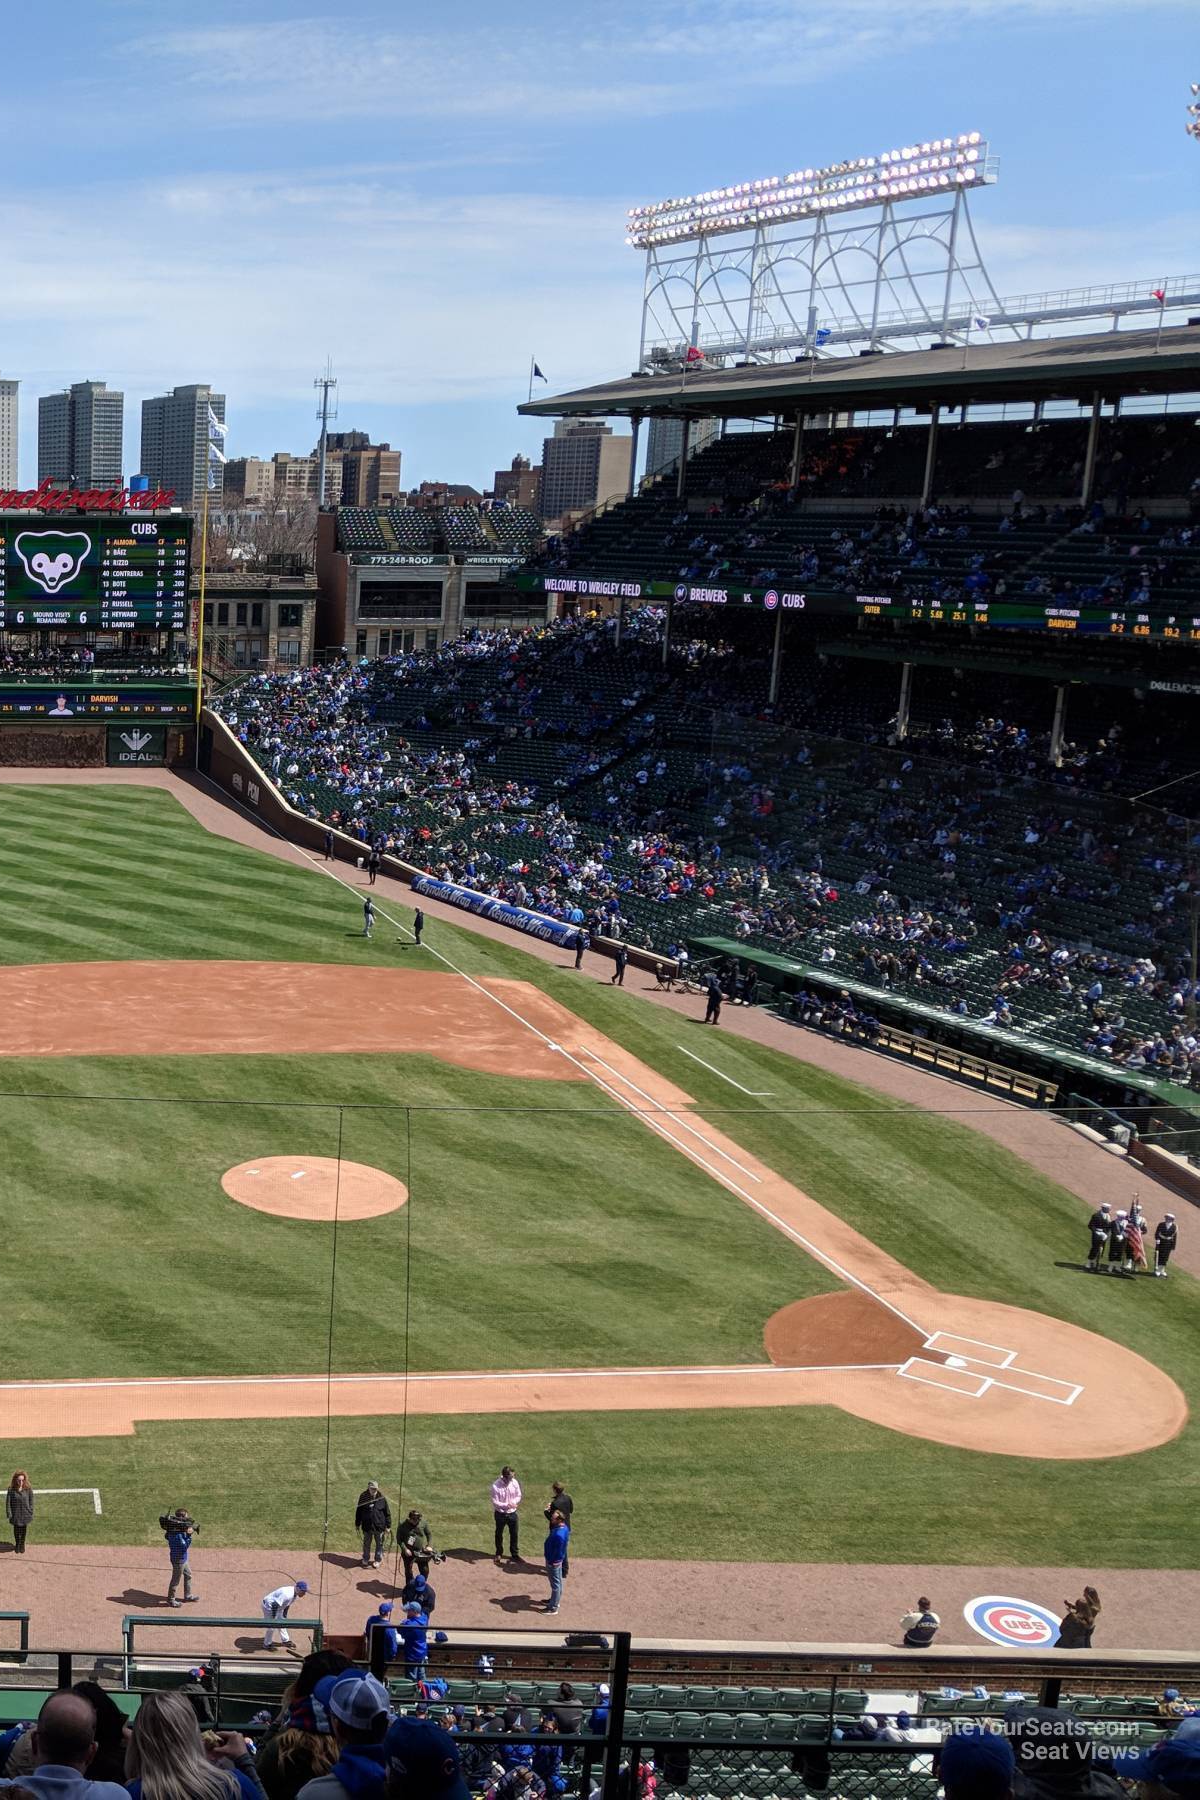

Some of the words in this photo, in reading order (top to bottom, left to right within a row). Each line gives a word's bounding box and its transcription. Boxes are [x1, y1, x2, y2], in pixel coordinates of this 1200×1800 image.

[131, 523, 157, 534] CUBS
[370, 556, 434, 564] 773-248-ROOF
[544, 579, 576, 592] WELCOME
[578, 581, 587, 593] TO
[588, 581, 620, 595] WRIGLEY
[620, 583, 641, 597] FIELD
[690, 587, 728, 603] BREWERS
[782, 593, 806, 608] CUBS
[856, 595, 874, 604] VISITING
[864, 605, 881, 614] SUTER
[931, 600, 941, 608] ERA
[17, 611, 24, 623] 6
[80, 611, 87, 624] 6
[912, 609, 922, 617] 1-2
[953, 612, 966, 621] 25.1
[1045, 608, 1059, 617] CUBS
[1059, 609, 1080, 617] PITCHER
[1048, 619, 1077, 629] DARVISH
[1169, 616, 1175, 624] IP
[1111, 624, 1124, 633] 0-2
[1164, 627, 1180, 637] 19.2
[119, 752, 153, 761] IDEAL
[416, 878, 451, 899] Reynolds
[450, 890, 471, 908] Wrap
[488, 903, 527, 929] Reynolds
[526, 918, 552, 939] Wrap
[988, 1609, 1048, 1641] CUBS
